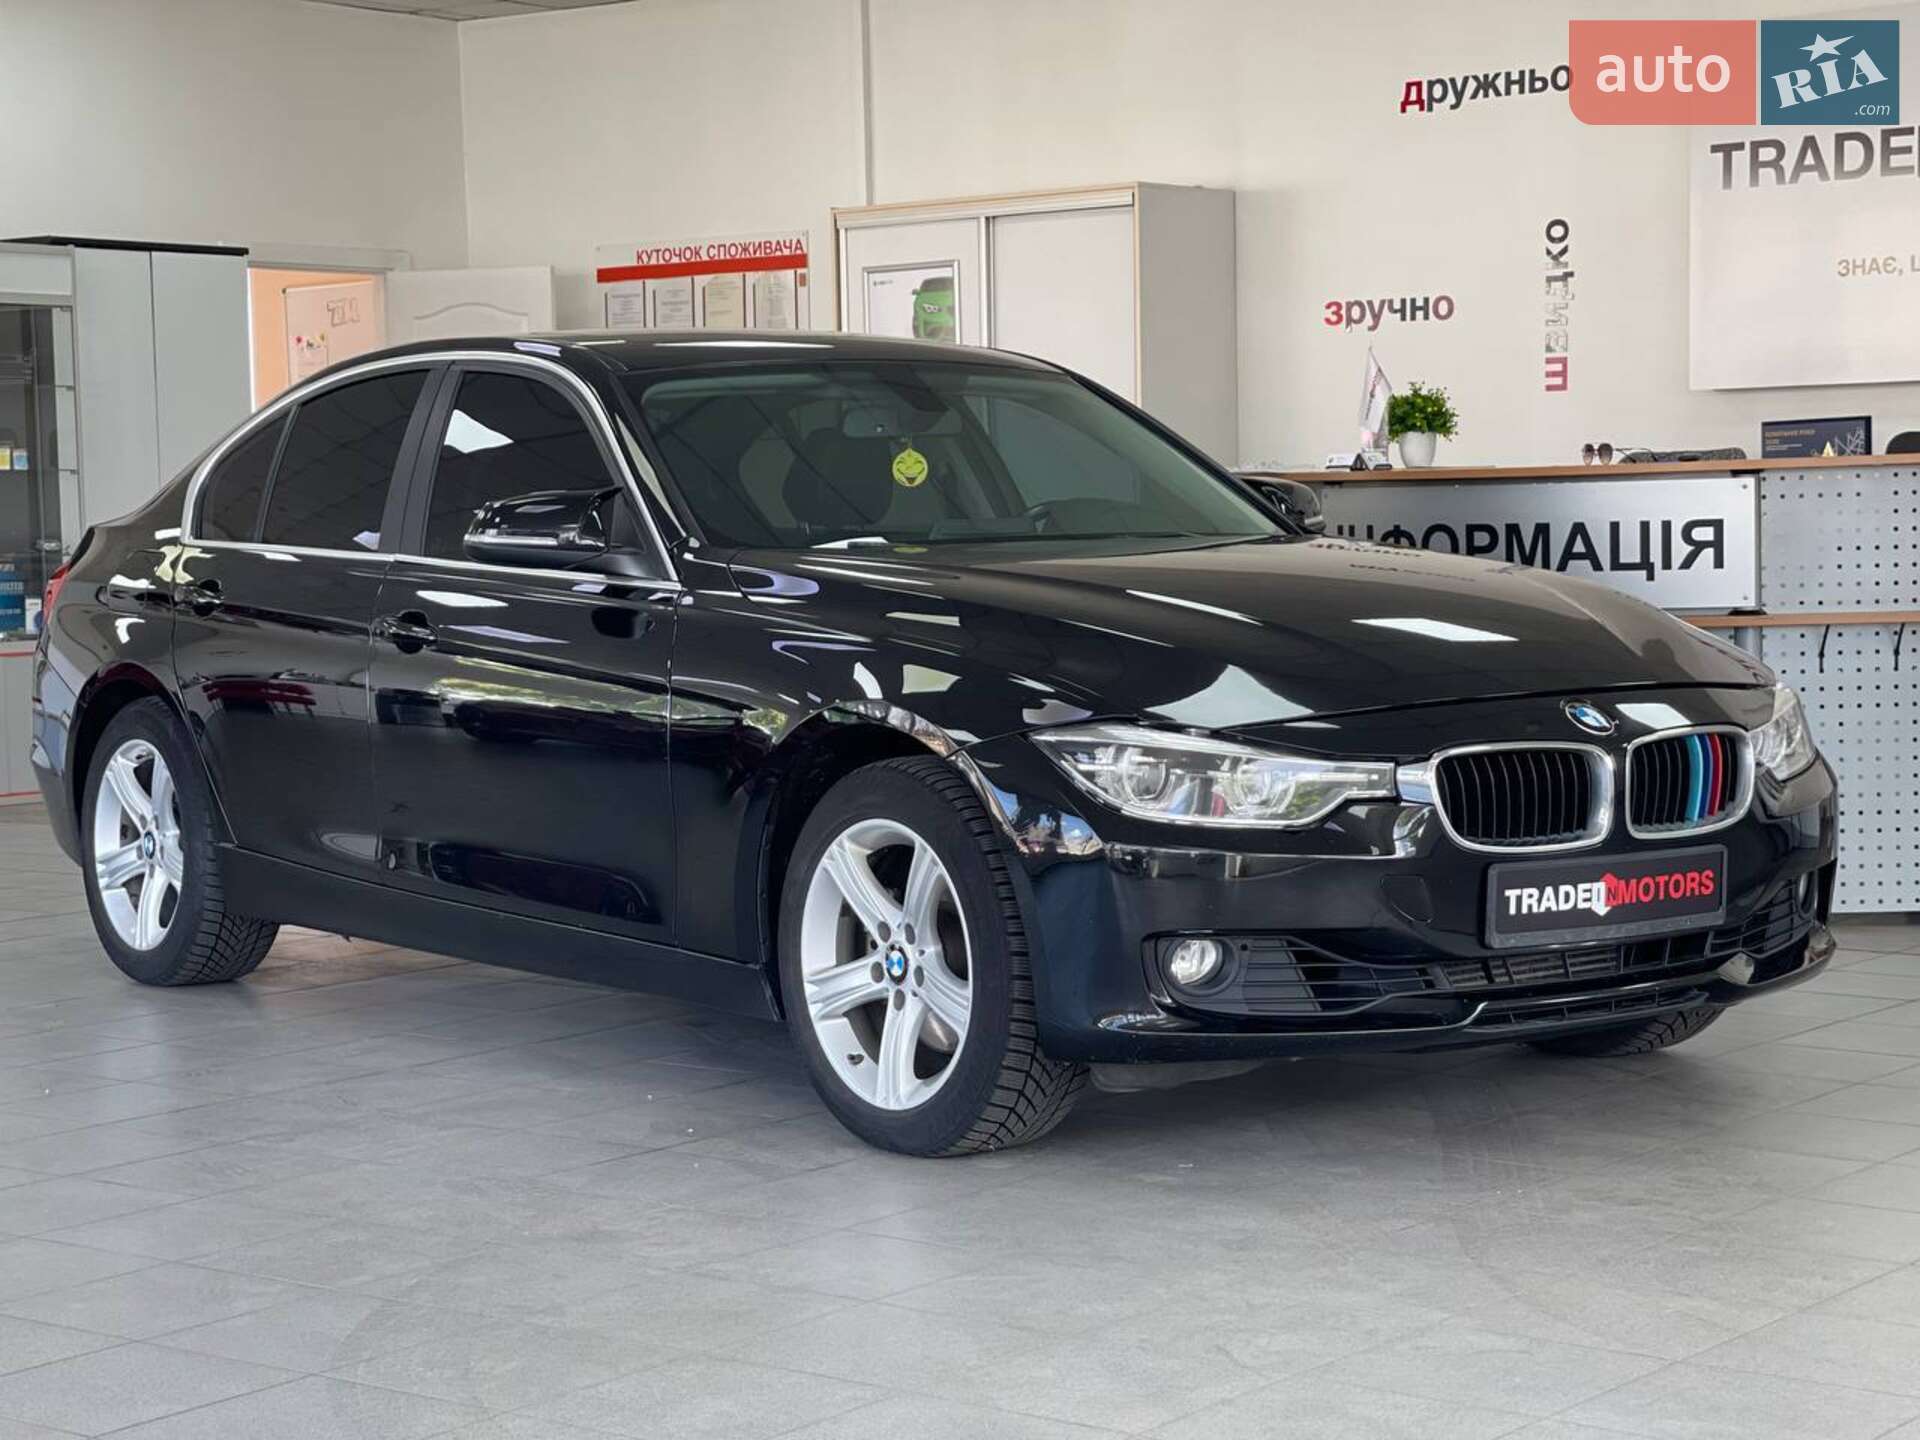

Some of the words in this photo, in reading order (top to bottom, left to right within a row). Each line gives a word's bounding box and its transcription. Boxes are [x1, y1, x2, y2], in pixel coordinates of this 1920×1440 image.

[1400, 65, 1571, 114] дружньо
[636, 245, 704, 265] КУТОЧОК
[706, 238, 805, 260] СПОЖИВАЧА
[1837, 256, 1904, 278] ЗНАЄ,
[1324, 295, 1455, 332] зручно
[1337, 518, 1725, 582] ОРМАЦІЯ
